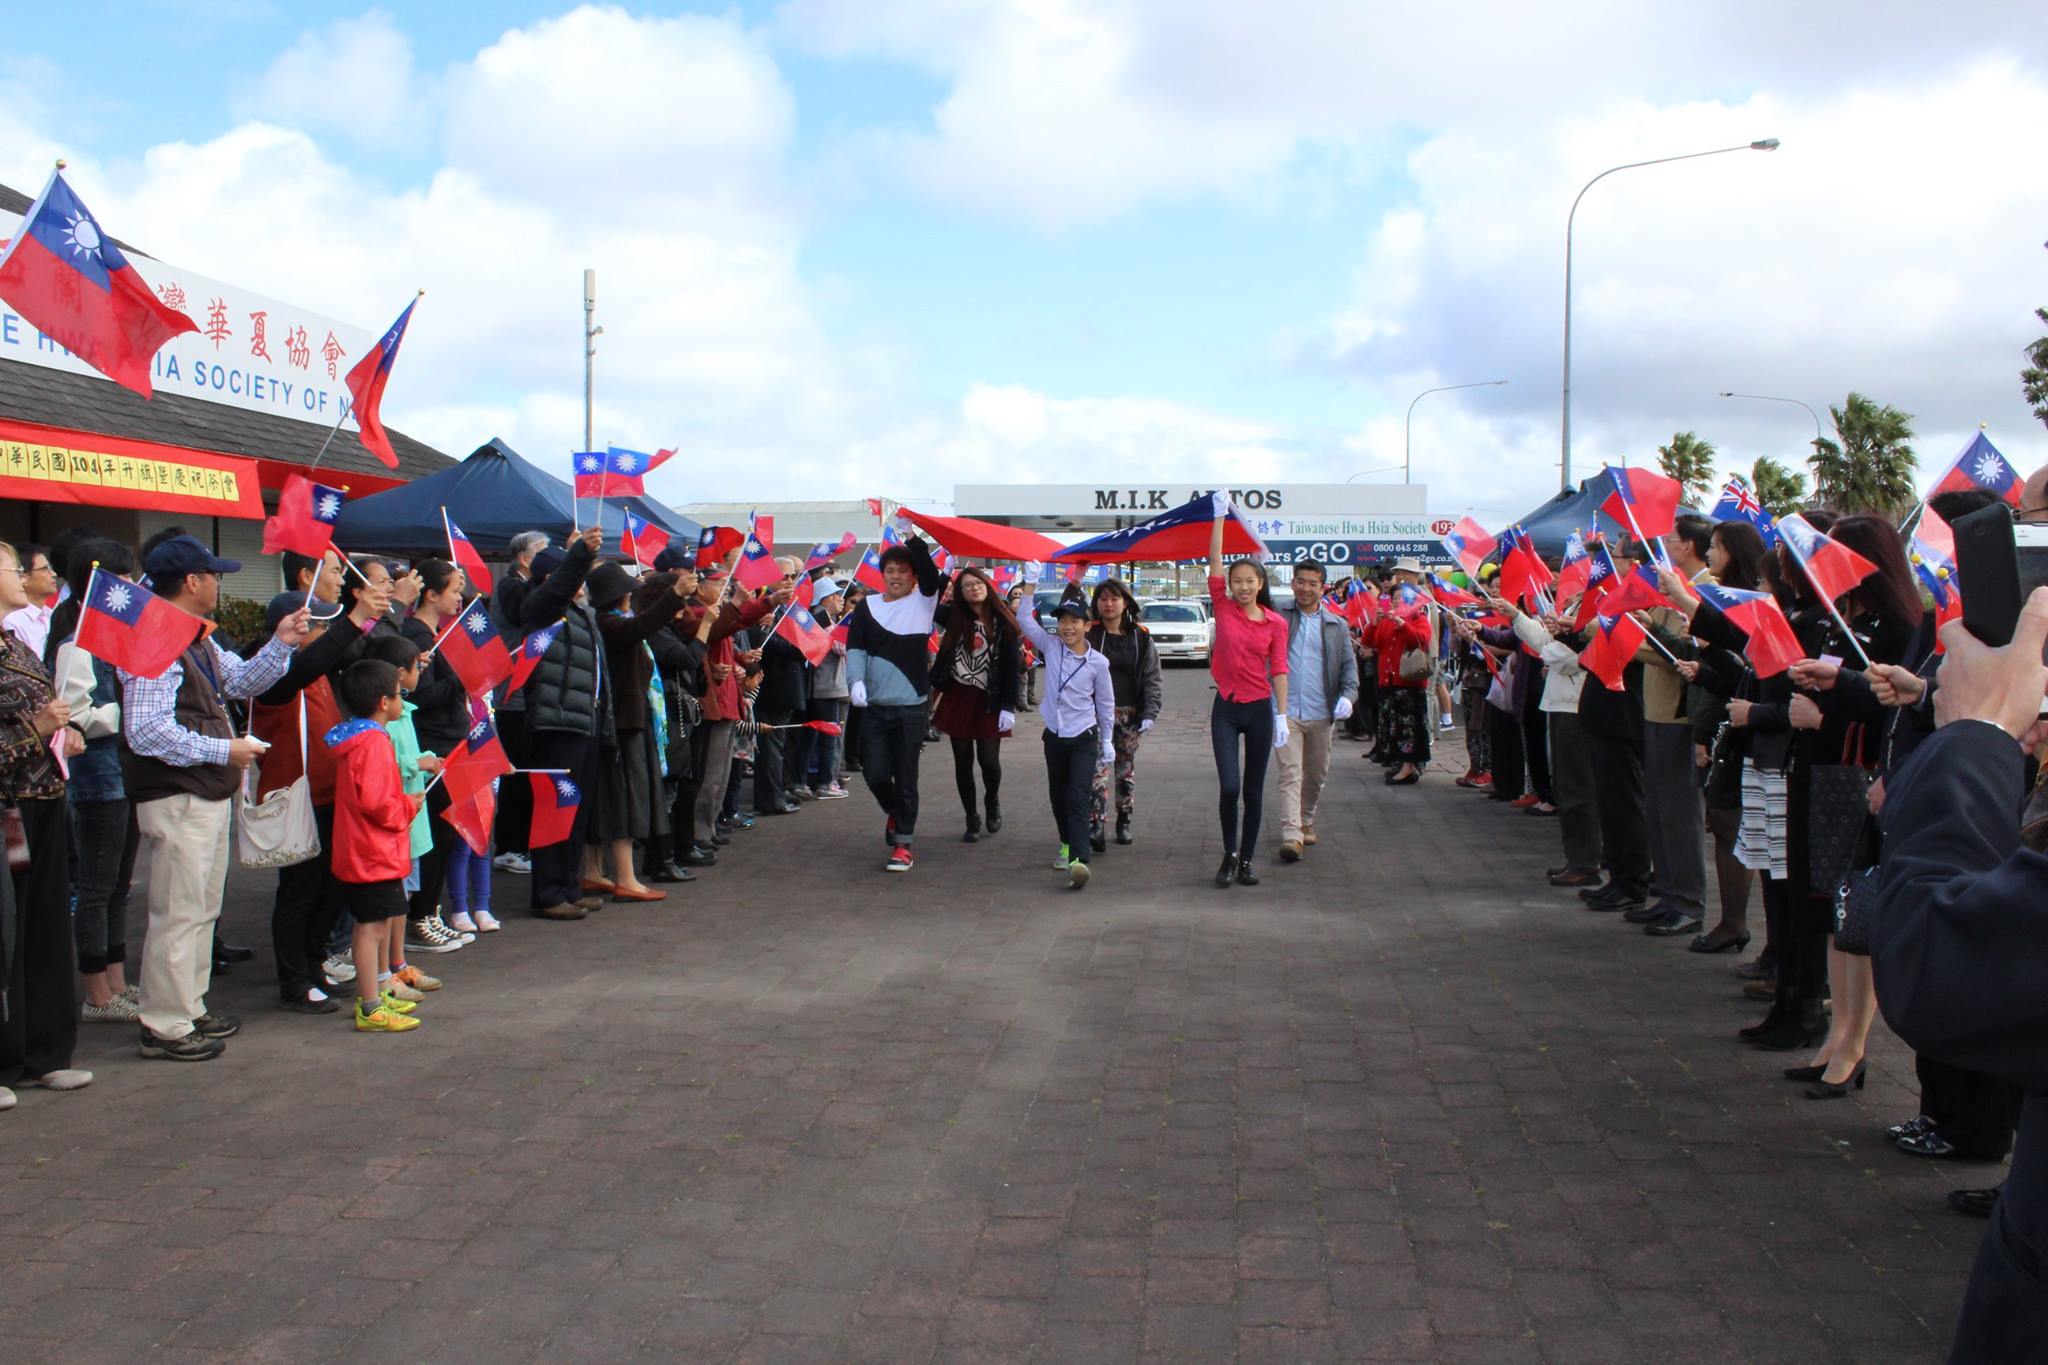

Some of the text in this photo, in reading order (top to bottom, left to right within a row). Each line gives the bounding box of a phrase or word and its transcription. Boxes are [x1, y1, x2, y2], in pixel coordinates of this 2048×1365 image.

[194, 361, 293, 405] SOCIETY
[304, 388, 328, 412] OF
[1095, 490, 1282, 509] M.I.K ATOS
[1288, 520, 1428, 538] Taiwanese Hwa Hsia Society
[1295, 542, 1350, 563] 2GO
[1373, 543, 1394, 552] 0800
[1395, 543, 1411, 552] 645
[1412, 543, 1428, 552] 288
